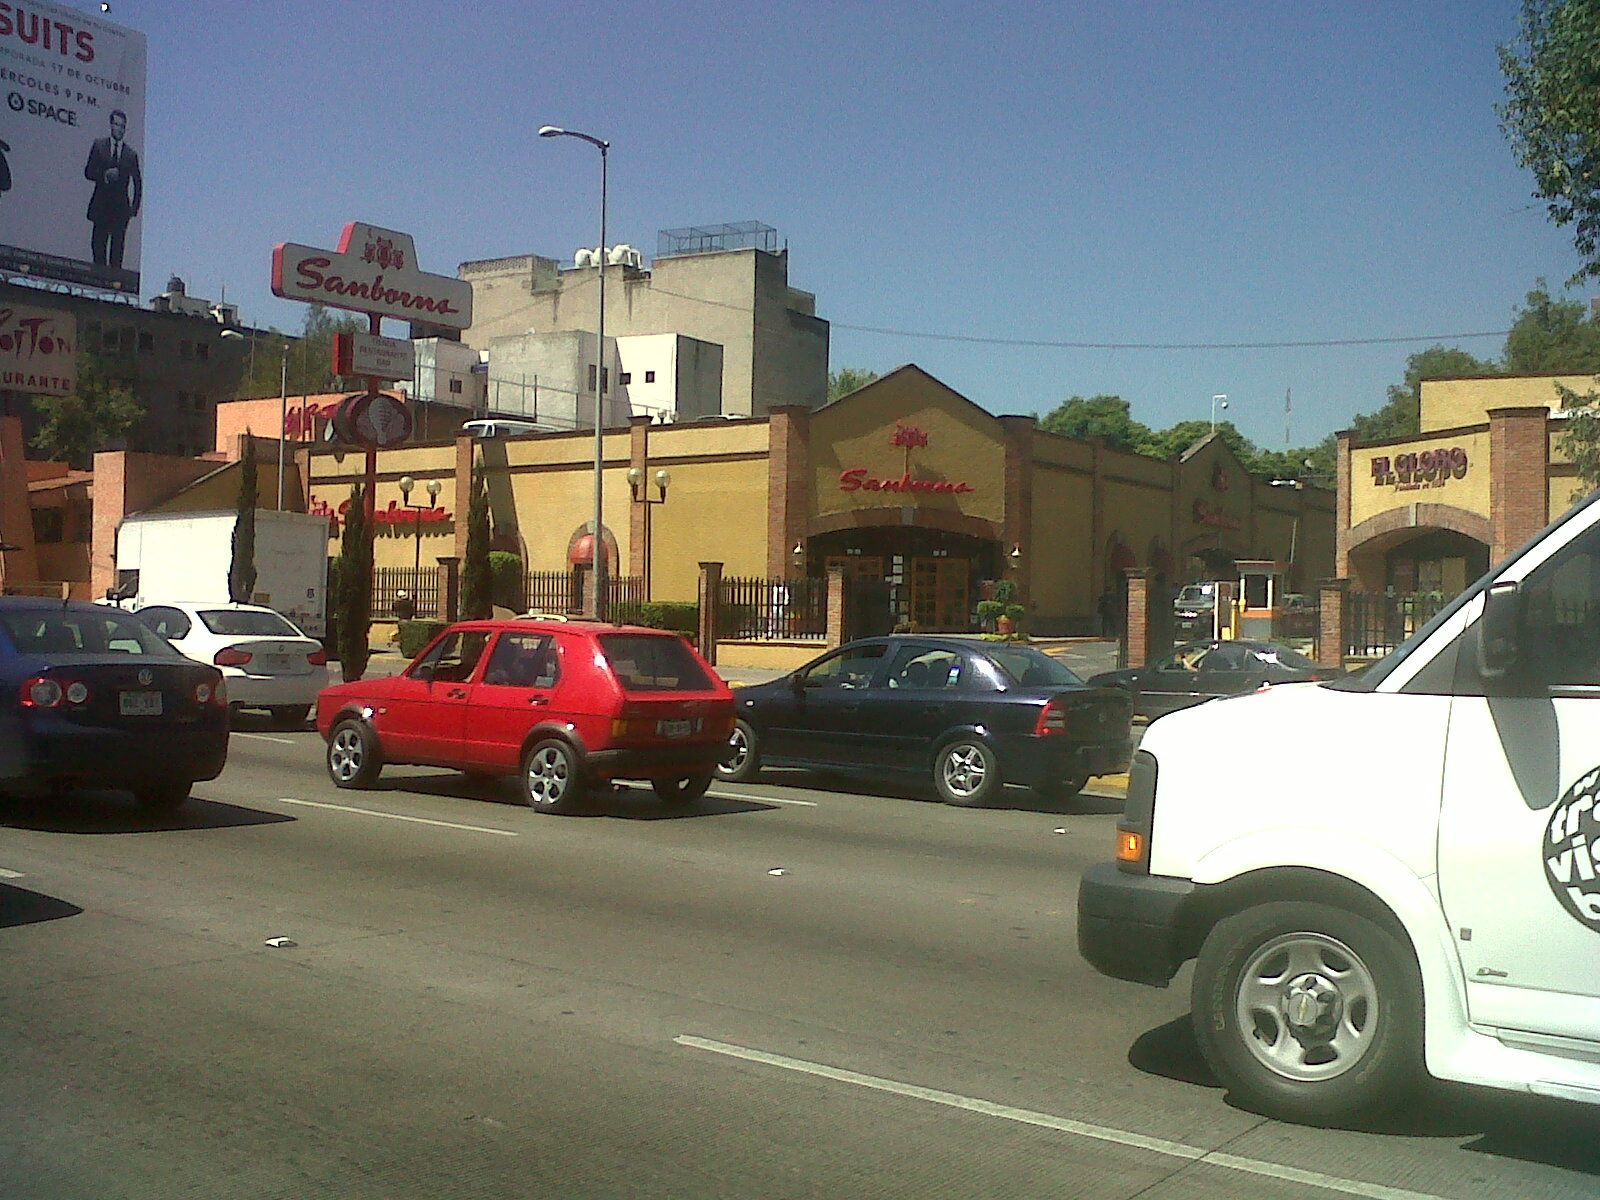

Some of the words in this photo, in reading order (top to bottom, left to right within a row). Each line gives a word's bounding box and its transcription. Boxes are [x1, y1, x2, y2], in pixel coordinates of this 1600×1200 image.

[0, 2, 95, 62] SUITS
[67, 68, 80, 79] DE
[85, 74, 130, 95] OCTUBRE
[28, 99, 77, 126] SPACE
[296, 257, 459, 314] Sanborns
[839, 468, 976, 494] Sanborns
